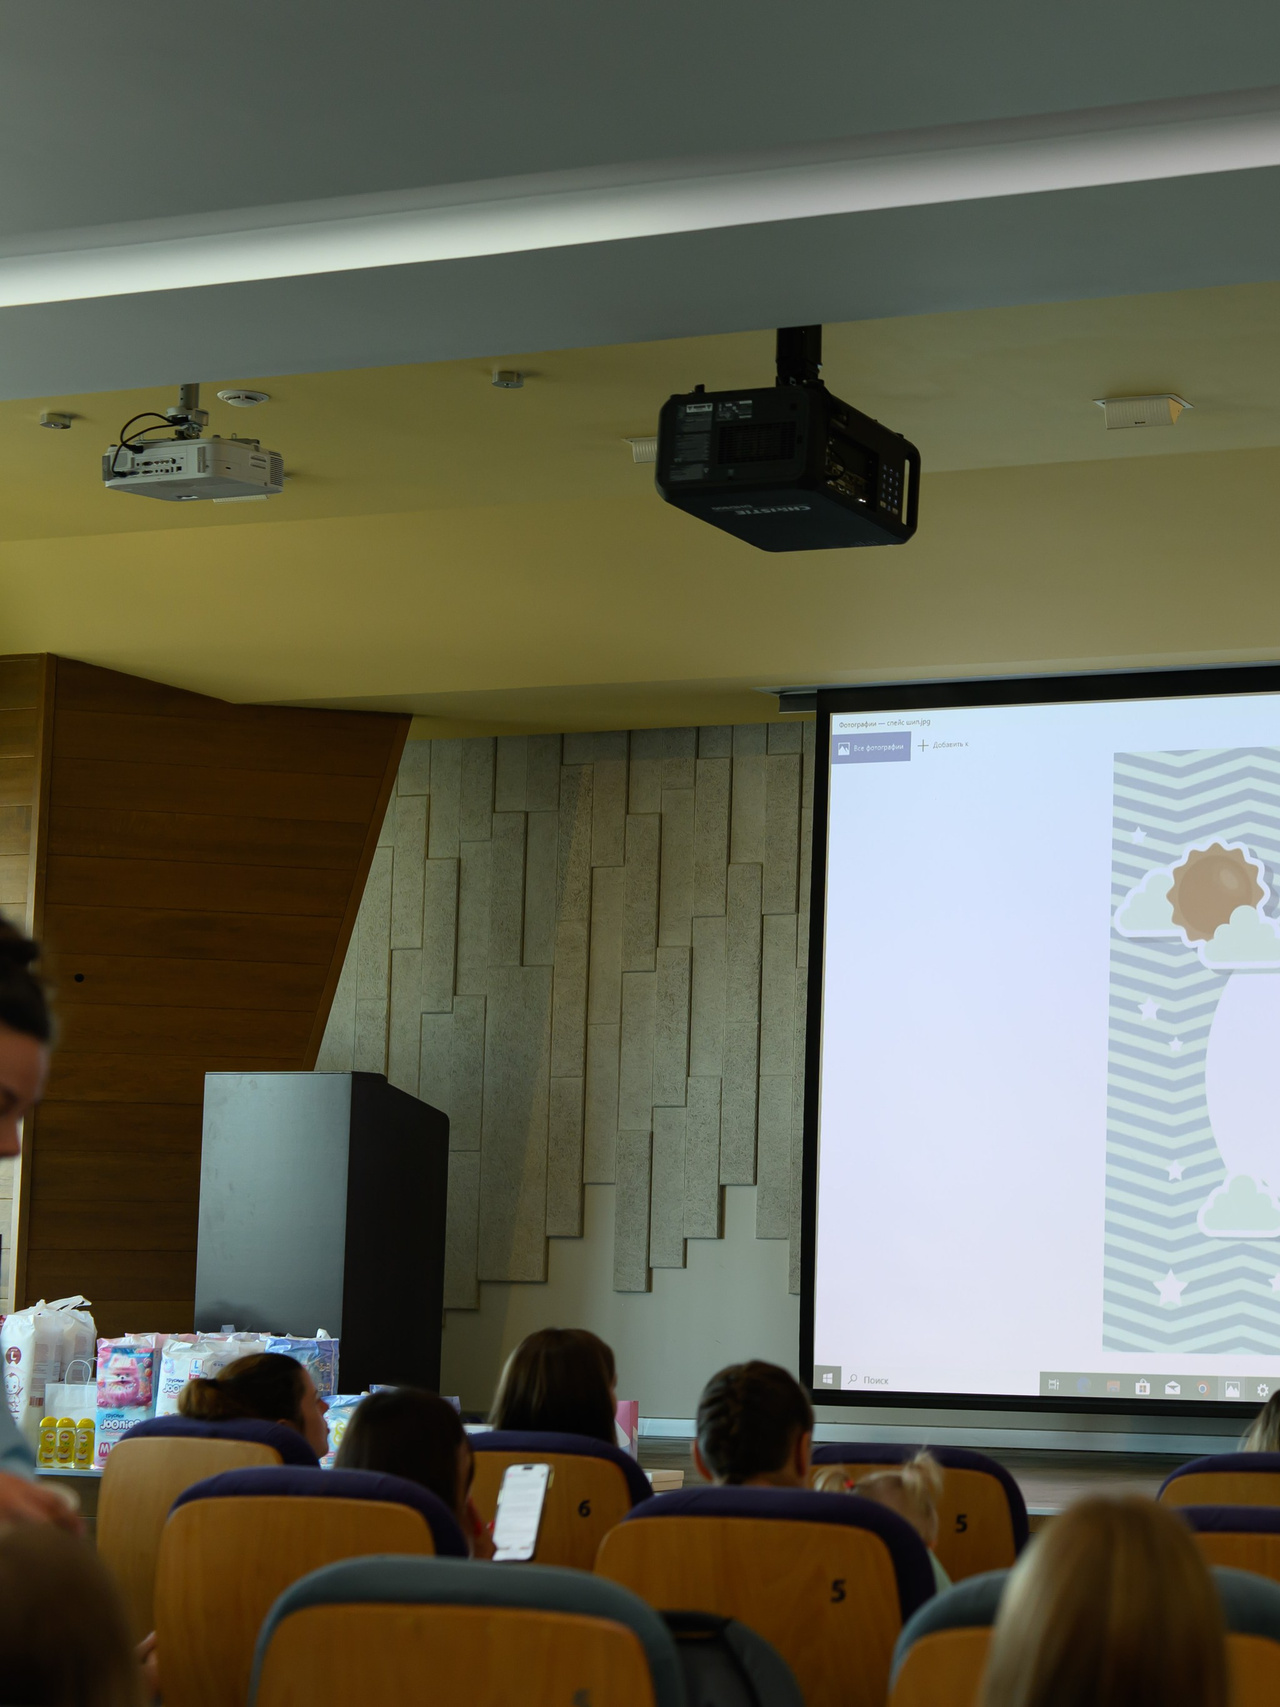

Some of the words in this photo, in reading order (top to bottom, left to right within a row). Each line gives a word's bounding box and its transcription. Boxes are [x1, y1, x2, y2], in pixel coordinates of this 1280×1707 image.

[734, 504, 812, 516] CHRISTIE
[838, 720, 877, 730] Фотографии
[886, 719, 905, 727] спейс
[853, 744, 864, 752] Все
[865, 743, 904, 753] фотографии
[932, 740, 963, 750] Добавить
[863, 1375, 889, 1385] Поиск
[577, 1499, 591, 1518] 6
[955, 1514, 967, 1533] 5
[830, 1579, 846, 1603] 5
